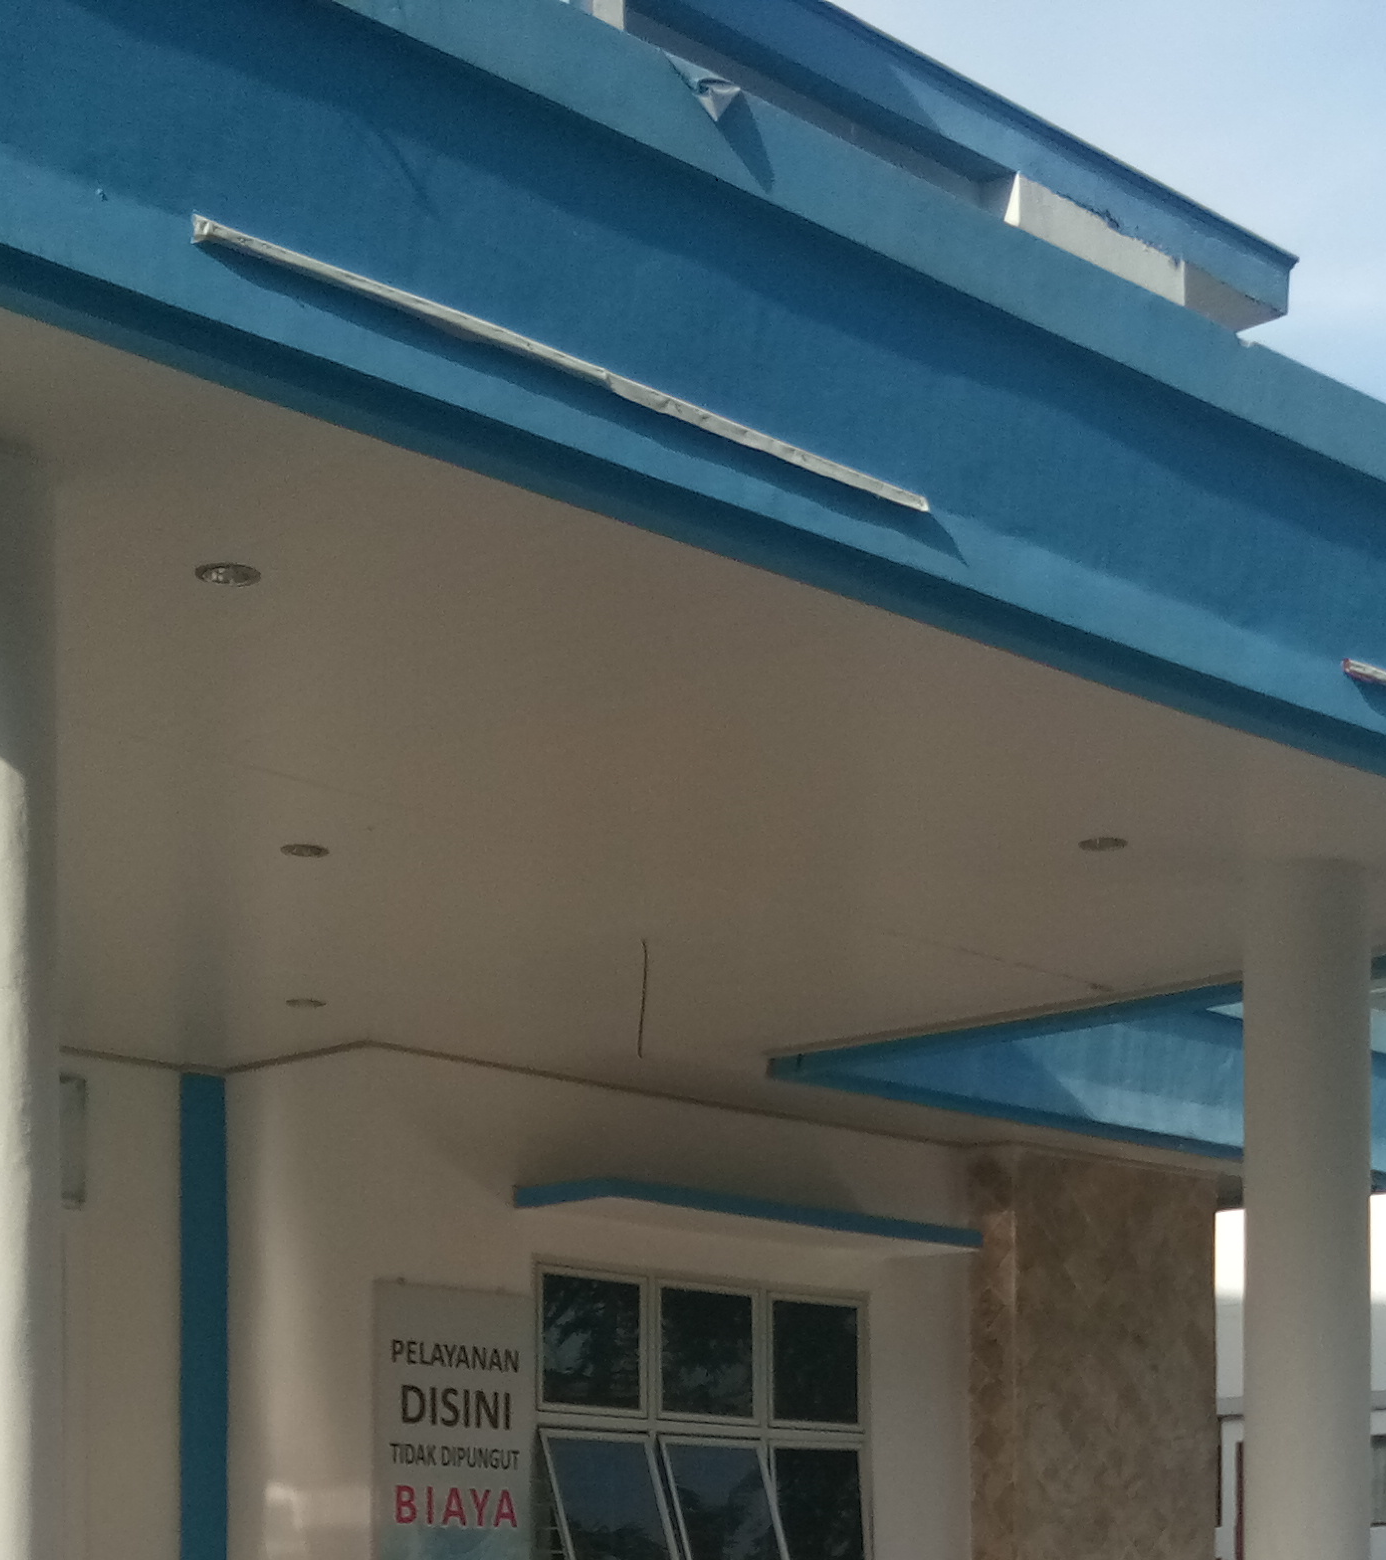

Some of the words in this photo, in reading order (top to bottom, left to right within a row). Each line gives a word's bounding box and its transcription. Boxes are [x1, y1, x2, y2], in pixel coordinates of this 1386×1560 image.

[390, 1339, 521, 1373] PELAYANAN
[401, 1384, 512, 1430] DISINI
[389, 1443, 438, 1467] TIDAK
[441, 1446, 521, 1470] DIPUNGUT
[395, 1485, 518, 1528] BIAYA
